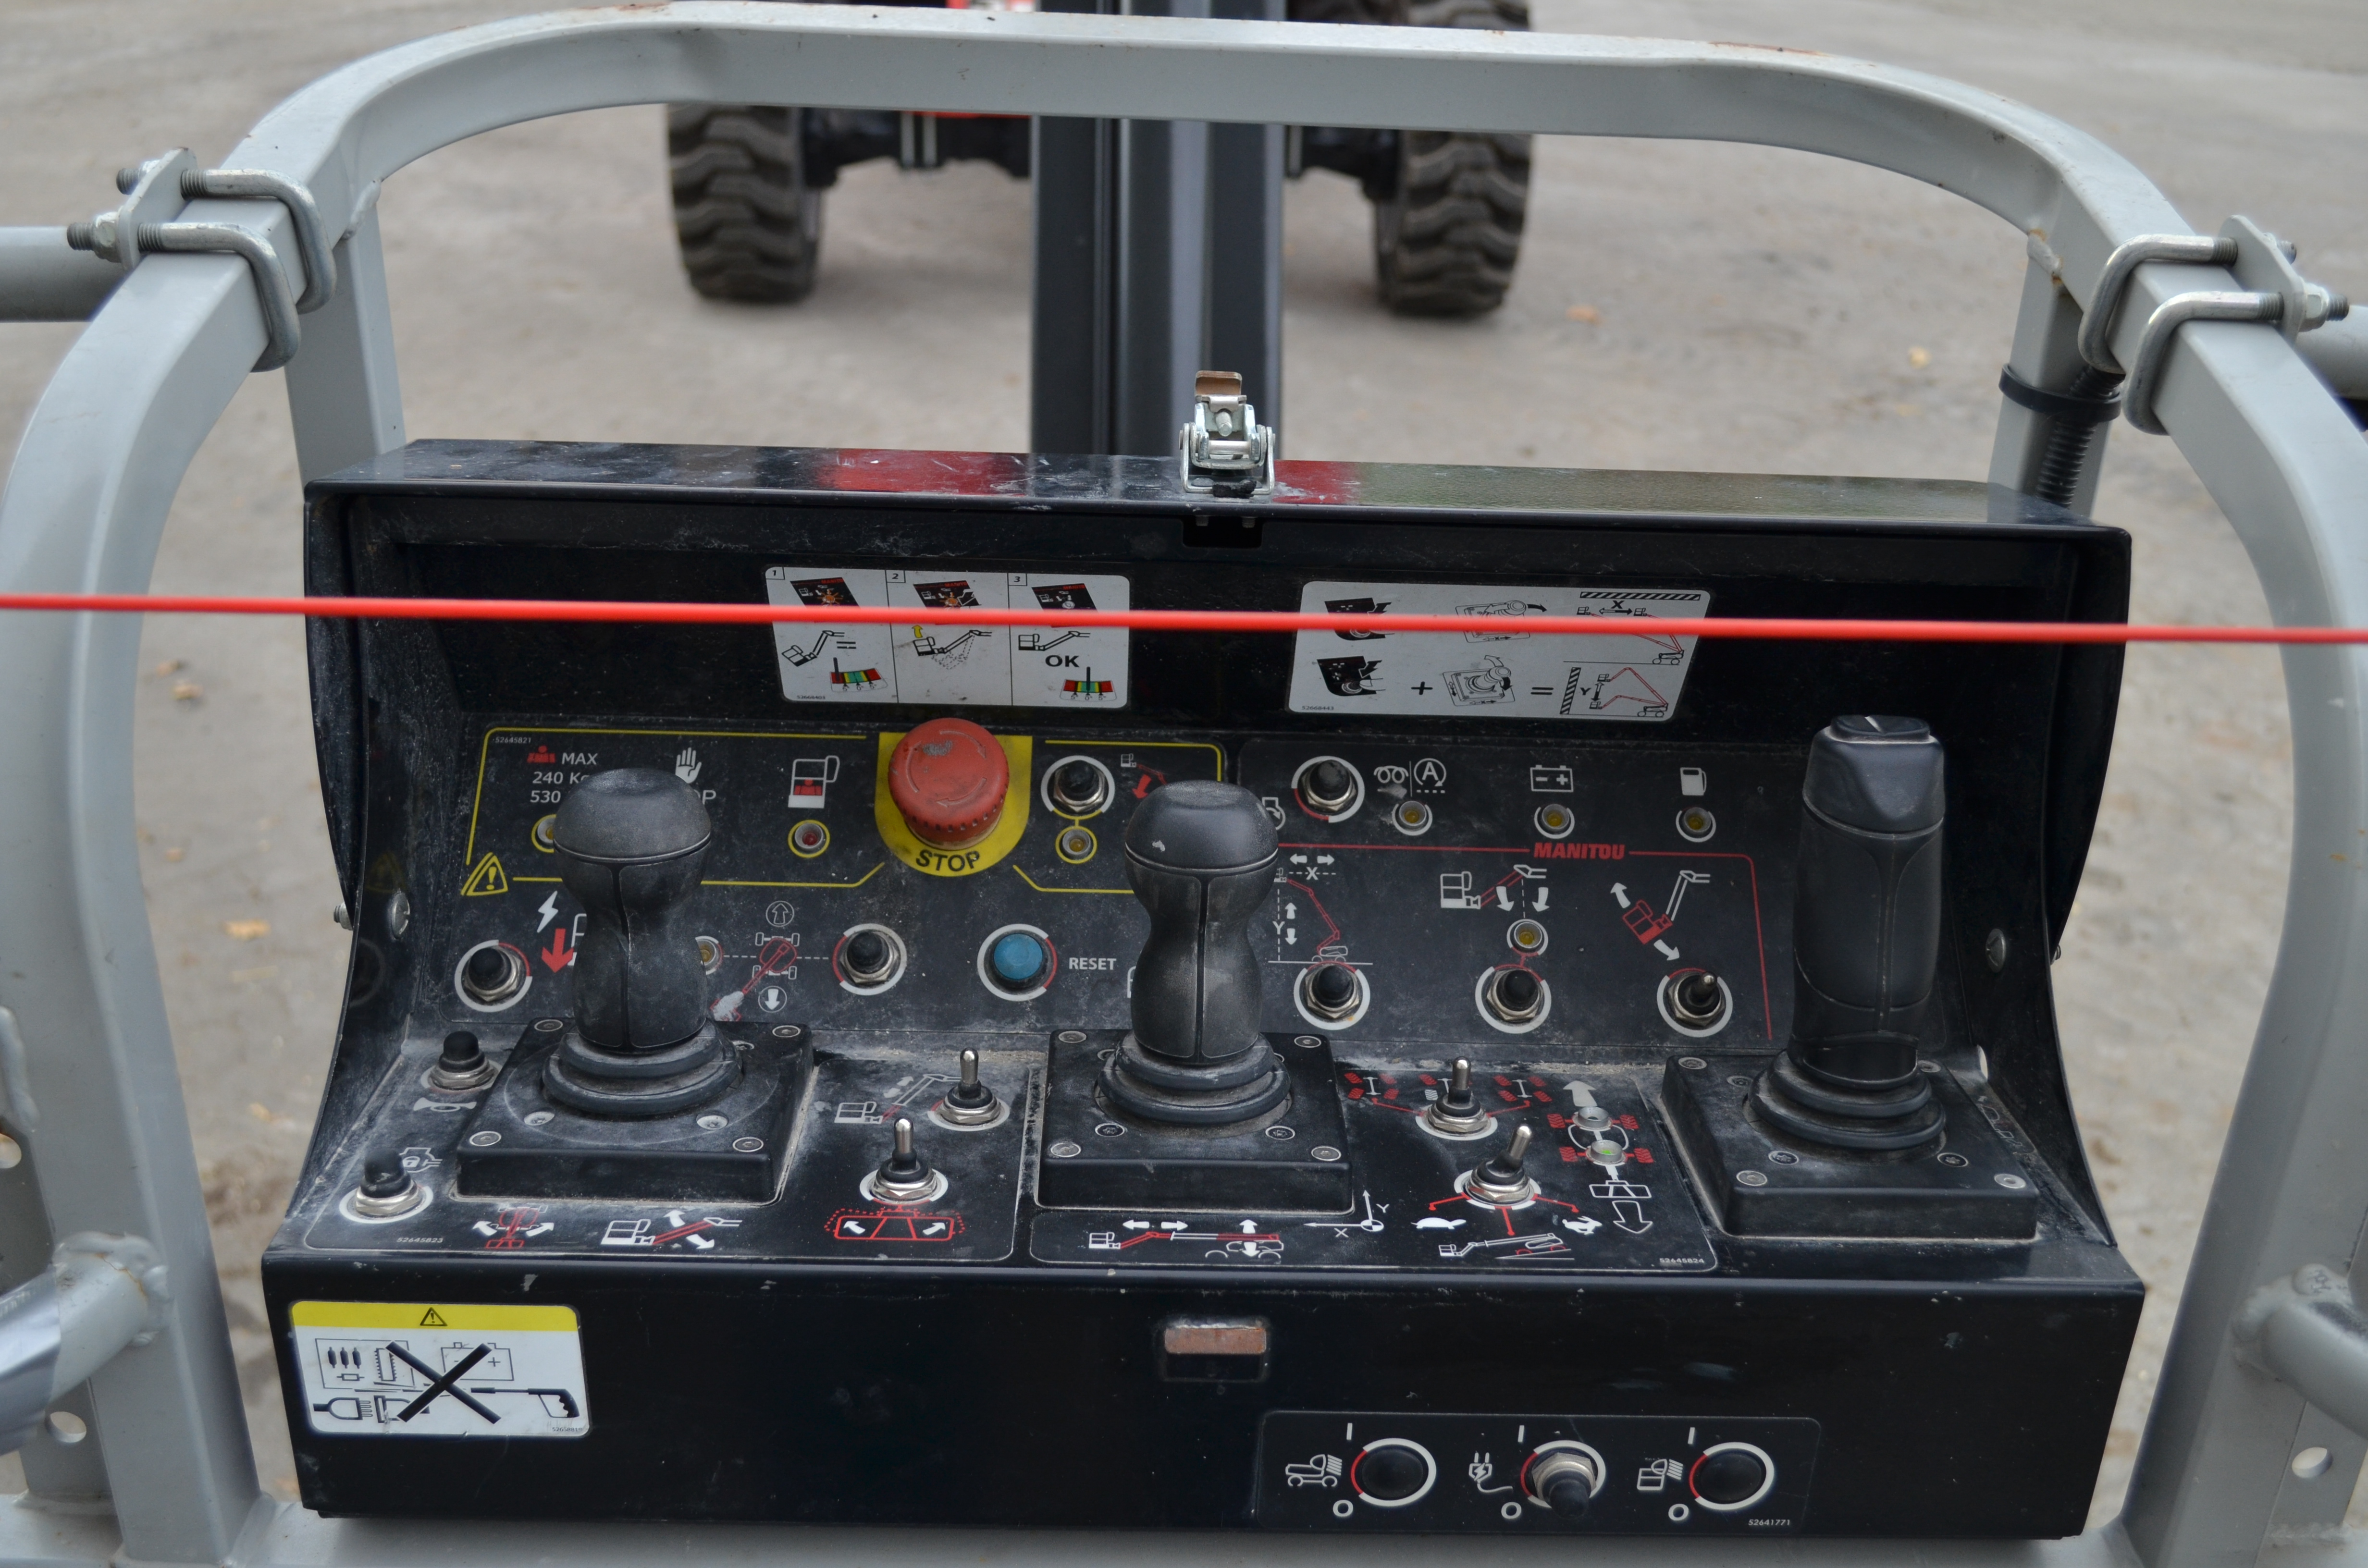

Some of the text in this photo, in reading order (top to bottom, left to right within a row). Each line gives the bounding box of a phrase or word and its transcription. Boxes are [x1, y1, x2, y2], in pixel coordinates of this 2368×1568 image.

[1611, 600, 1625, 609] X
[1045, 655, 1080, 667] OK
[1580, 687, 1591, 696] Y
[561, 752, 598, 765] MAX
[532, 771, 564, 784] 240
[1422, 761, 1439, 781] A
[530, 790, 561, 803] 530
[1533, 842, 1625, 860] MANITOU
[916, 849, 980, 872] STOP
[1306, 867, 1319, 880] X
[1272, 921, 1285, 935] Y
[1069, 957, 1117, 970] RESET
[1376, 1203, 1390, 1213] Y
[1334, 1227, 1349, 1237] X
